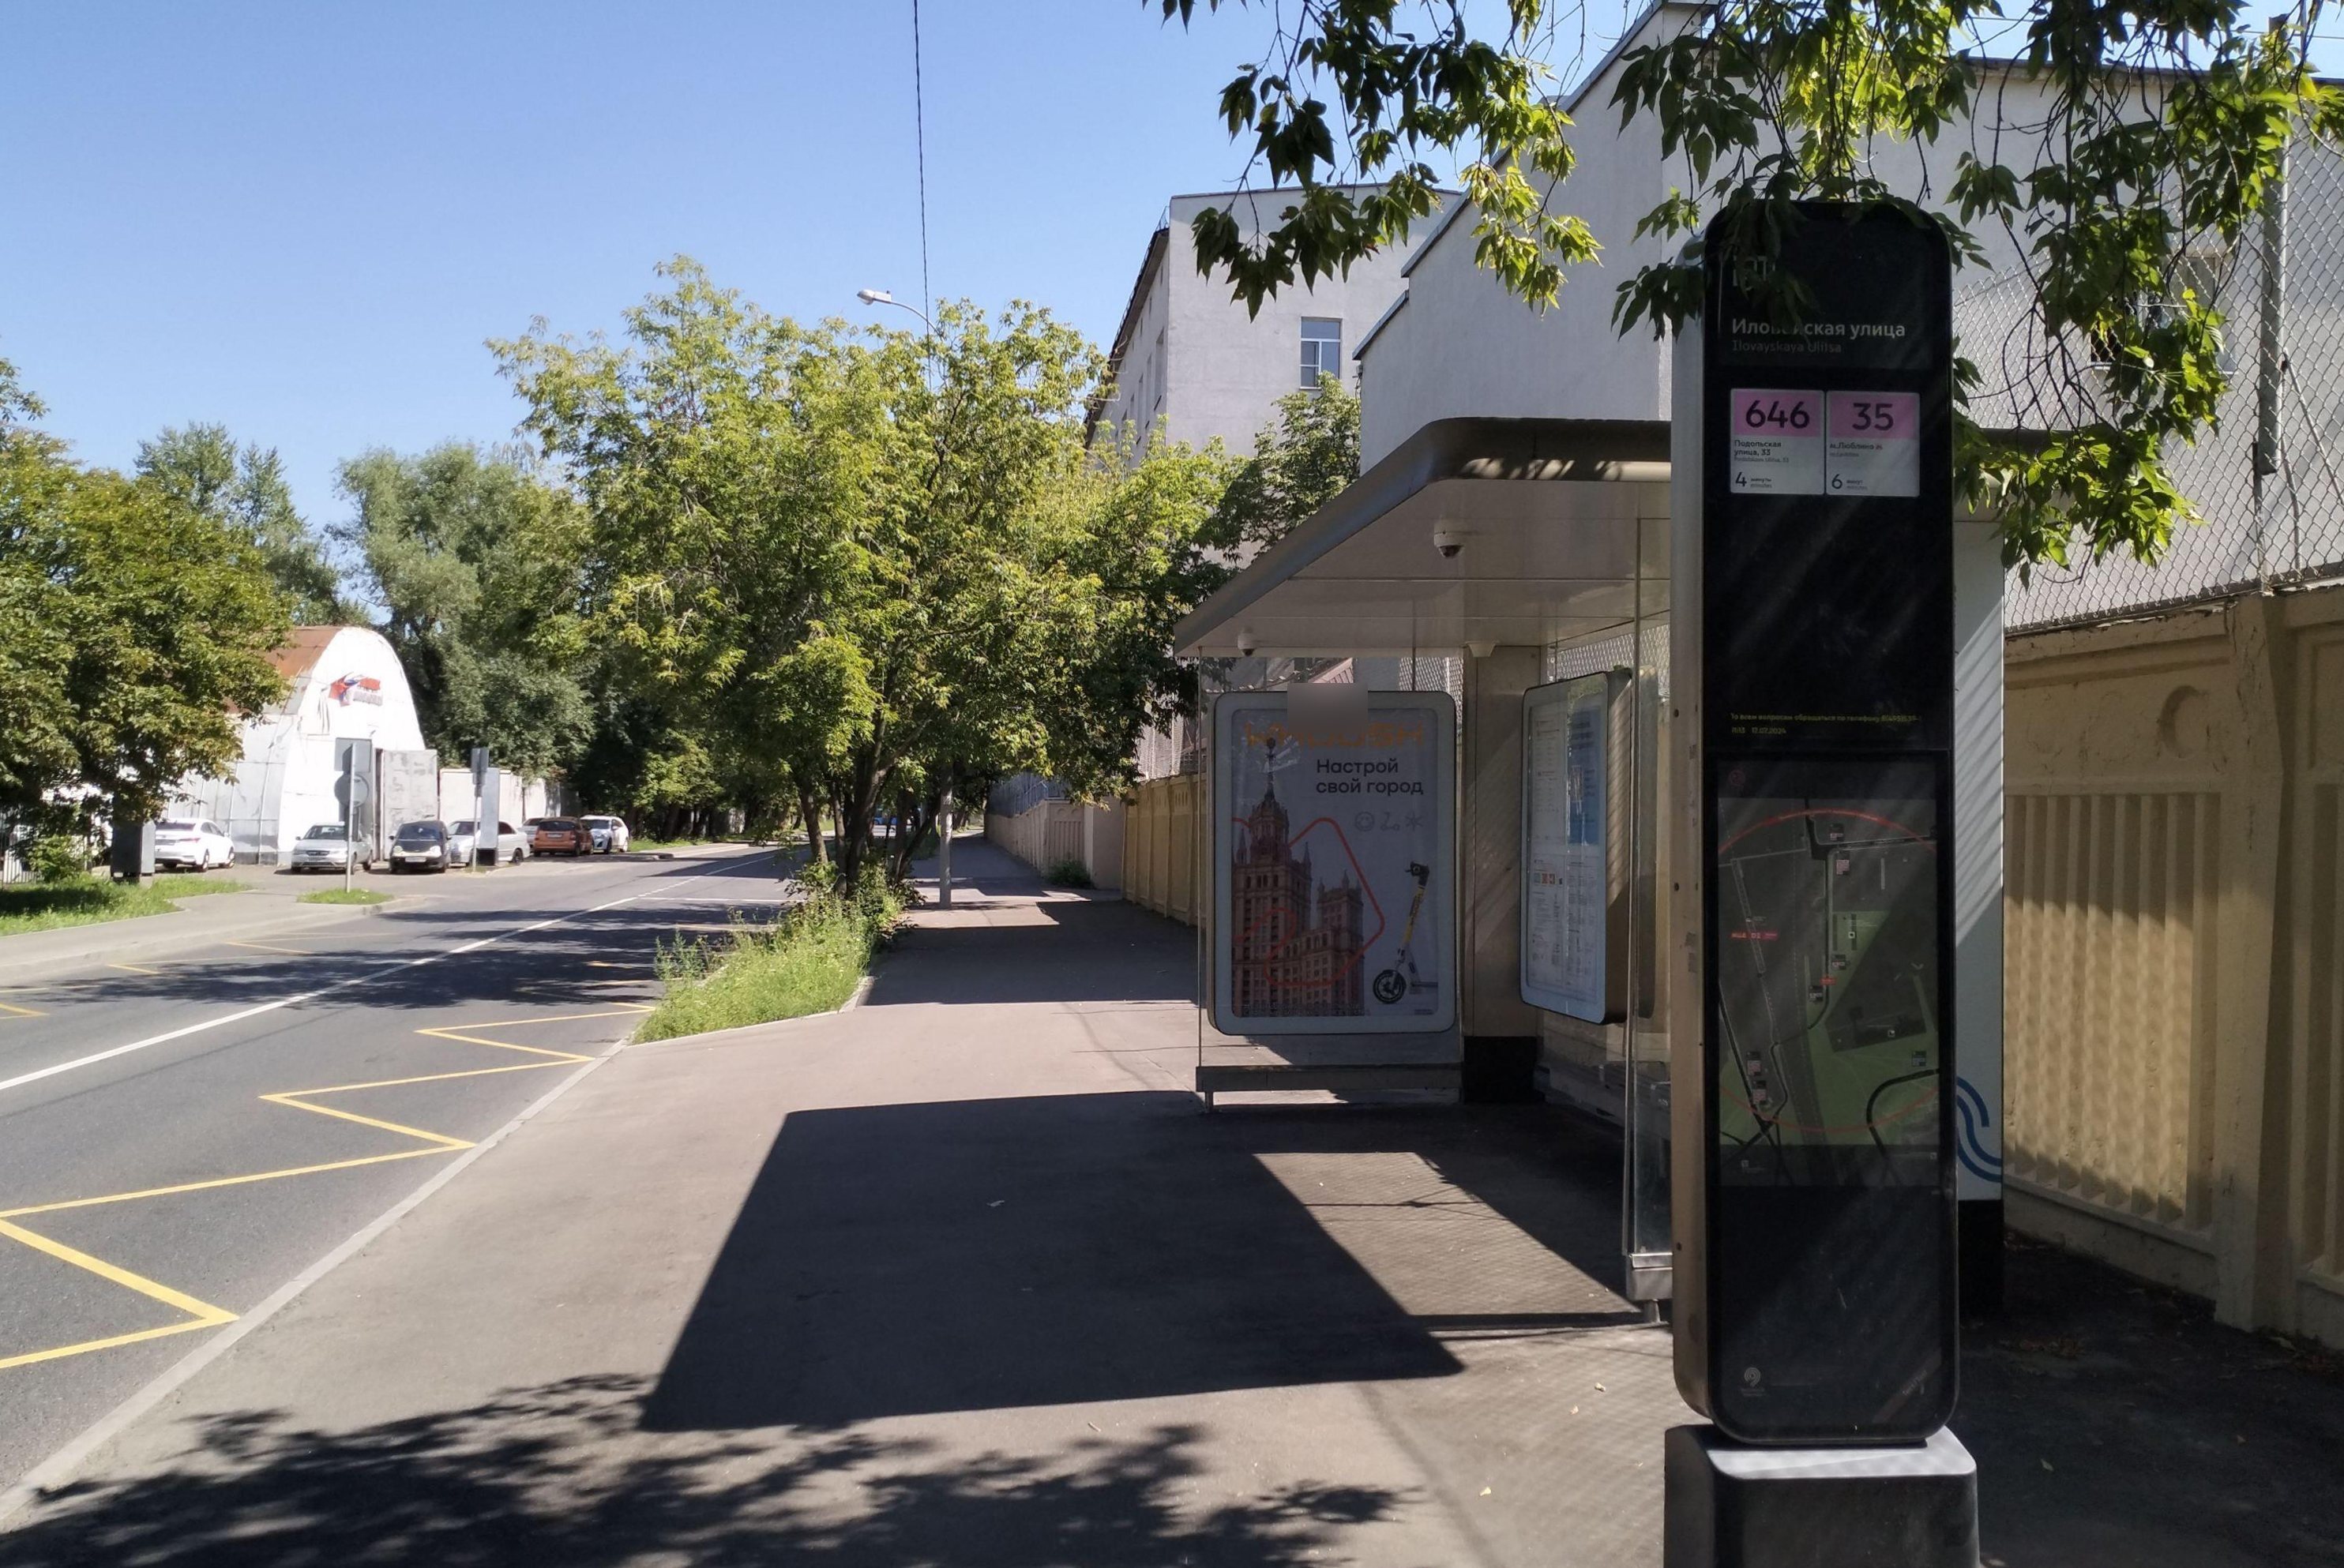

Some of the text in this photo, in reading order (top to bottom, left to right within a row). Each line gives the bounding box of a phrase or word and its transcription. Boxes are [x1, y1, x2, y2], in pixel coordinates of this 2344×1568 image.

[1850, 324, 1906, 339] улица
[1732, 340, 1804, 353] Ilovayskaya
[1745, 400, 1810, 429] 646
[1852, 402, 1894, 431] 35
[1734, 440, 1782, 448] Подольская
[1735, 471, 1747, 487] 4
[1831, 474, 1843, 490] 6
[1317, 759, 1399, 776] Настрой
[1317, 778, 1424, 796] свой город
